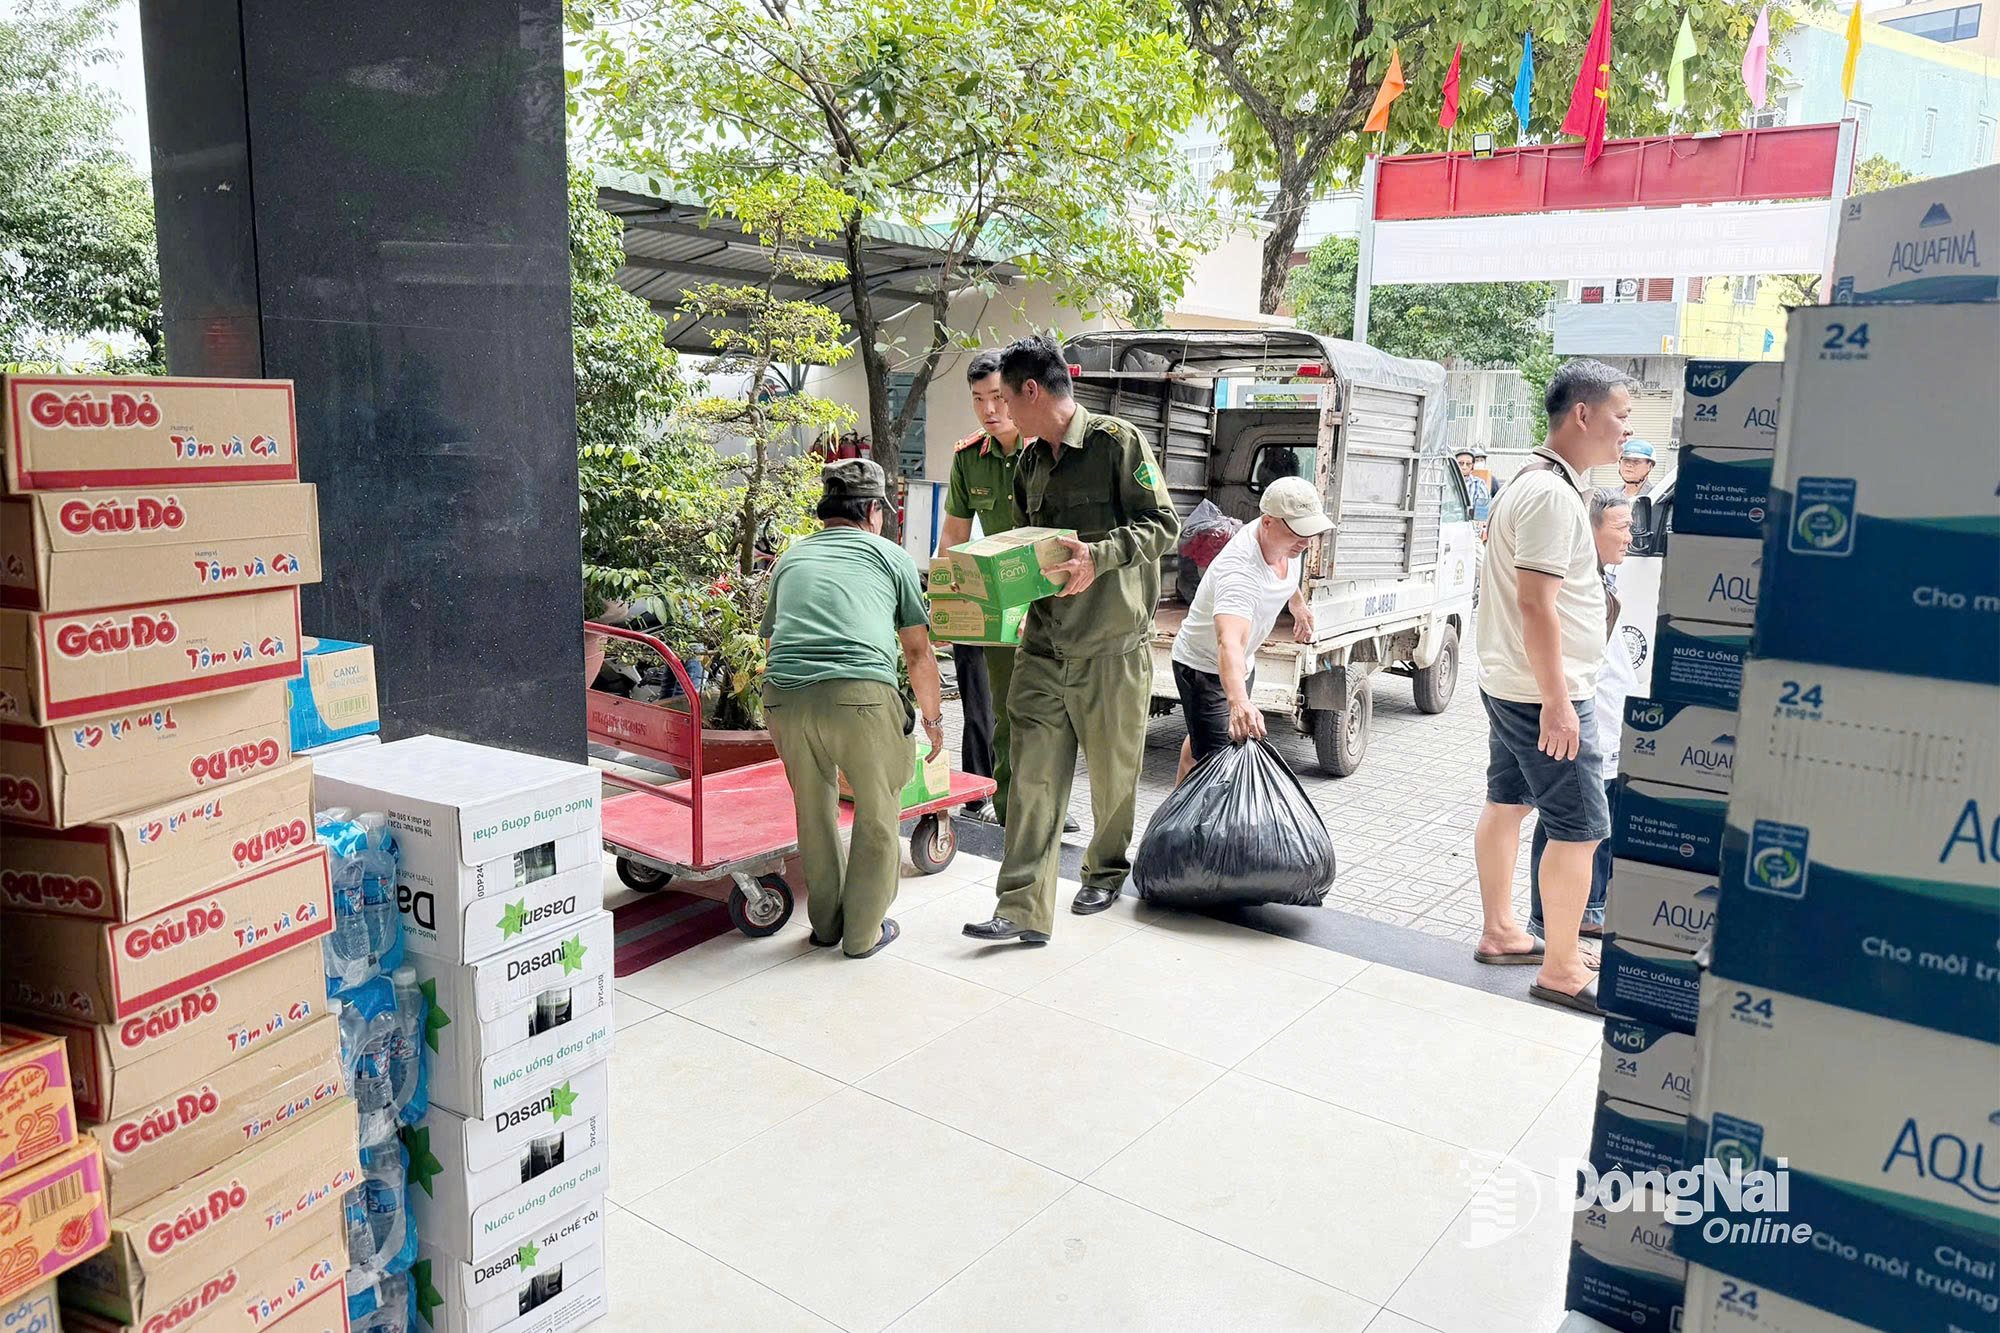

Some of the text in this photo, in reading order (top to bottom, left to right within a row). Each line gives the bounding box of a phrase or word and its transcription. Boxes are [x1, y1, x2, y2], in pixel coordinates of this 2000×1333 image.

[1849, 203, 1862, 216] 24
[1889, 230, 1981, 278] AQUAFINA
[1823, 323, 1870, 349] 24
[1696, 403, 1718, 417] 24
[1000, 563, 1027, 580] Fami
[1912, 586, 1966, 609] Cho
[1779, 682, 1823, 708] 24
[1635, 737, 1656, 751] 24
[518, 896, 576, 932] Dasani
[507, 941, 566, 982] Dasani
[1862, 936, 1968, 975] Cho môi
[1733, 991, 1774, 1018] 24
[586, 1027, 606, 1045] chai
[1616, 1058, 1638, 1073] 24
[495, 1090, 557, 1133] Dasani
[579, 1163, 601, 1183] chai
[1587, 1209, 1607, 1224] 24
[542, 1232, 558, 1247] TÁI
[561, 1218, 581, 1238] CHẾ
[474, 1248, 522, 1285] Dasani
[1811, 1231, 1999, 1313] Cho môi trường
[1934, 1245, 1995, 1280] Chai
[1720, 1282, 1759, 1310] 24
